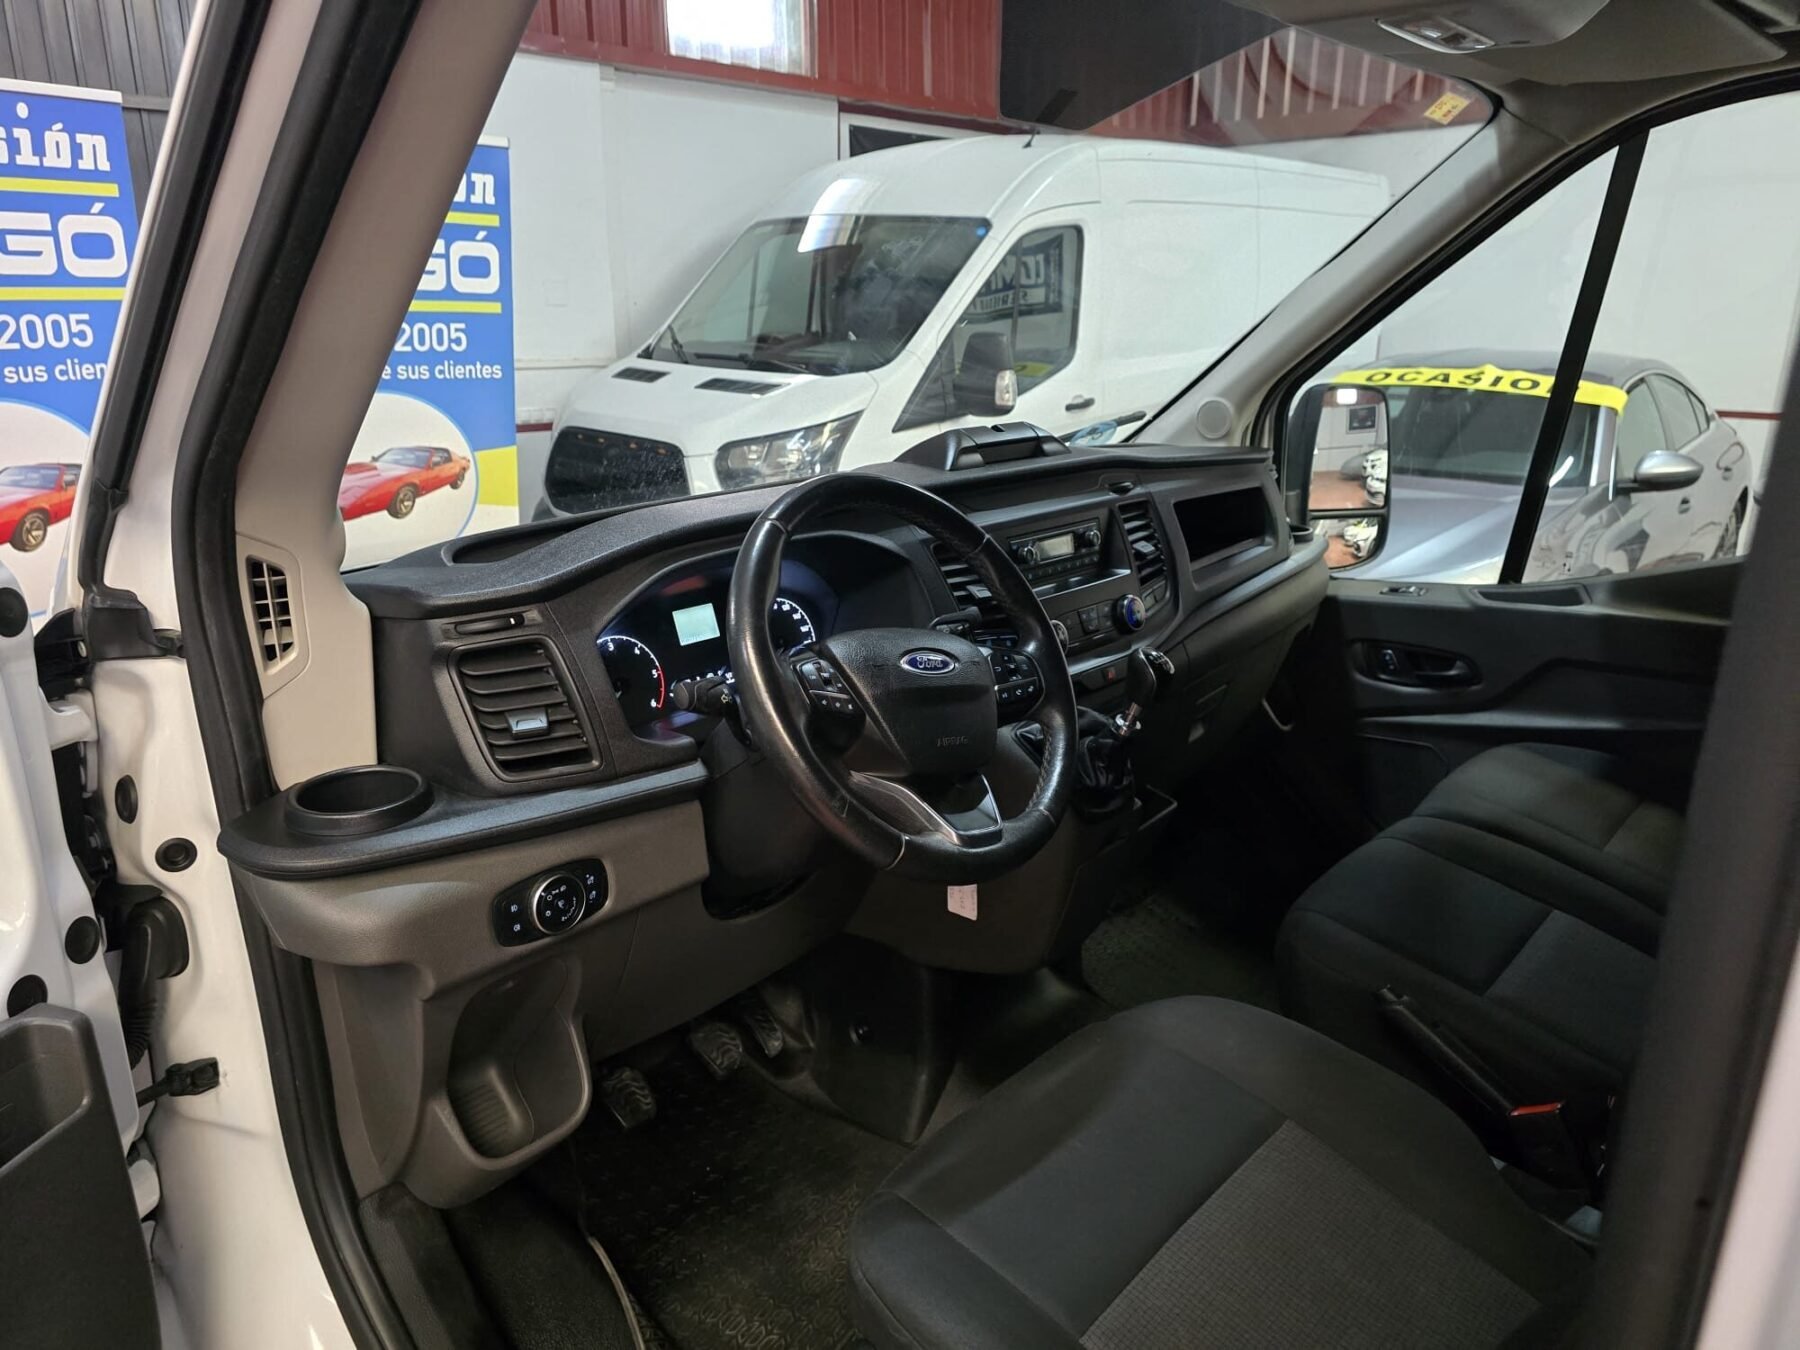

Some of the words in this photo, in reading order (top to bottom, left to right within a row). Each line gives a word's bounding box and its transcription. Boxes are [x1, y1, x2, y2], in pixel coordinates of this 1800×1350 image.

[0, 313, 94, 349] 2005
[394, 322, 468, 352] 2005
[3, 365, 48, 383] sus
[396, 365, 430, 379] sus
[434, 359, 503, 379] clientes
[1365, 368, 1580, 394] OCASIO
[916, 656, 944, 669] Ford
